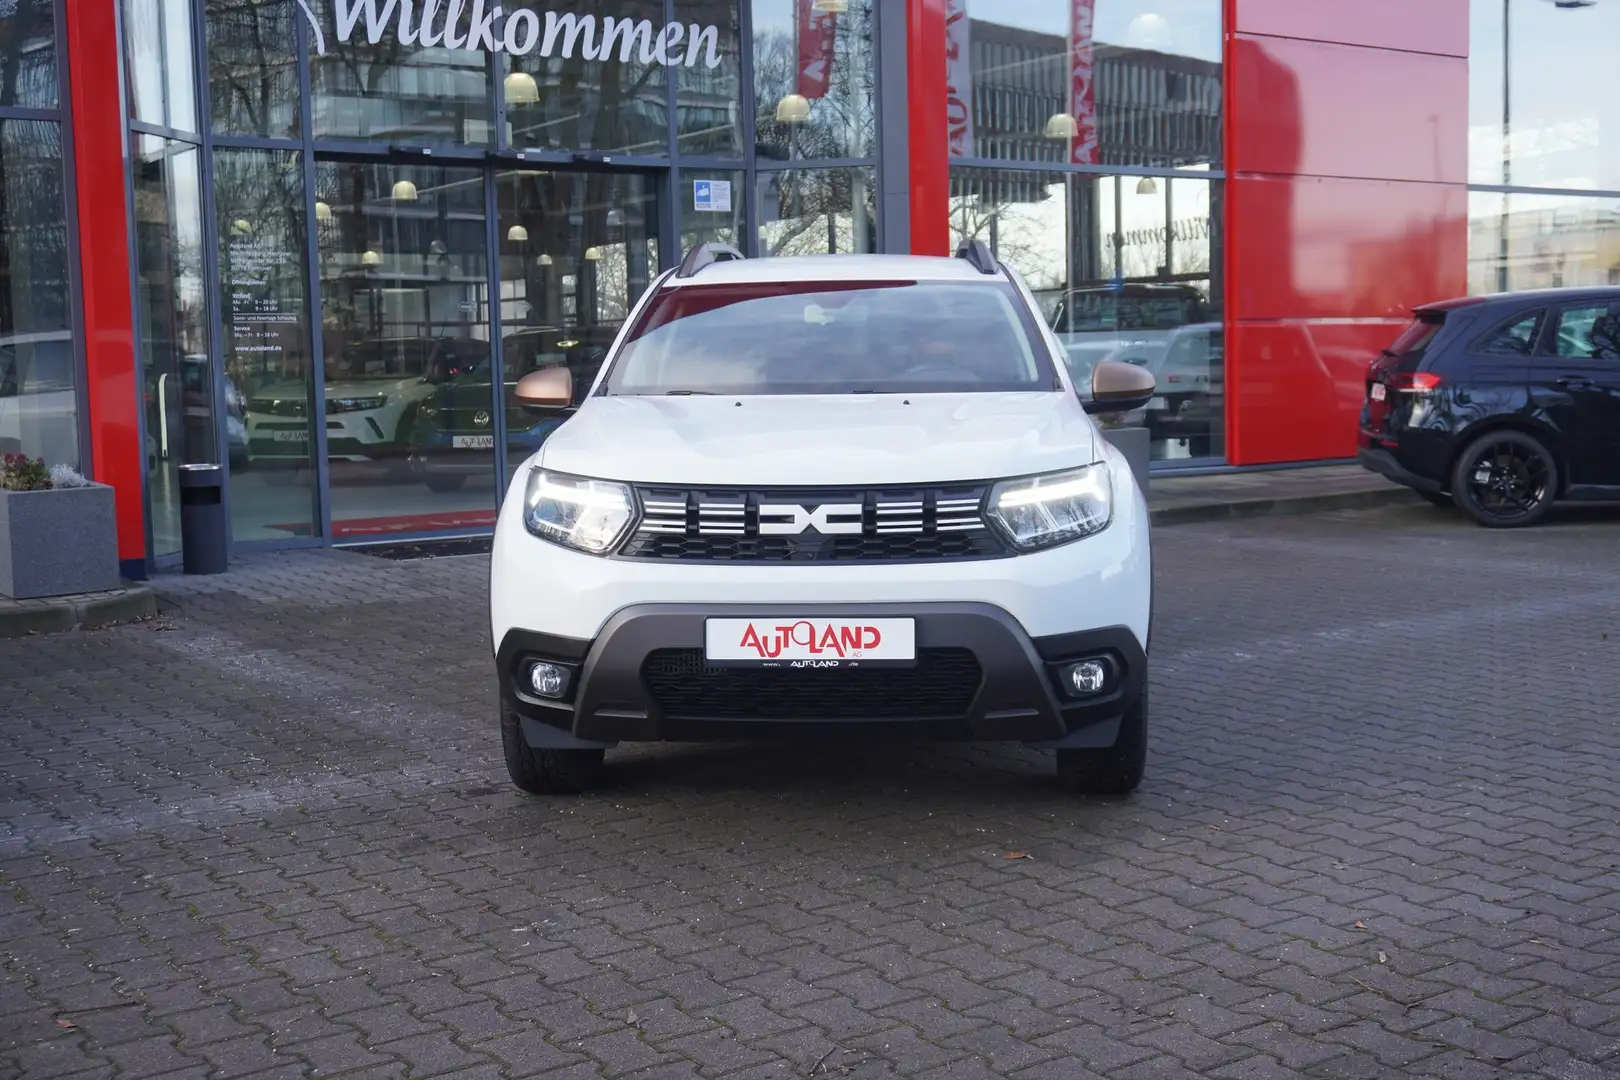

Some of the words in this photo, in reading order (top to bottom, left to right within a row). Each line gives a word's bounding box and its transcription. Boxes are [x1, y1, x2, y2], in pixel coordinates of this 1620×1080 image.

[332, 0, 722, 69] Willkommen
[740, 620, 881, 658] AUTOLAND
[790, 659, 839, 668] AUTOLAND
